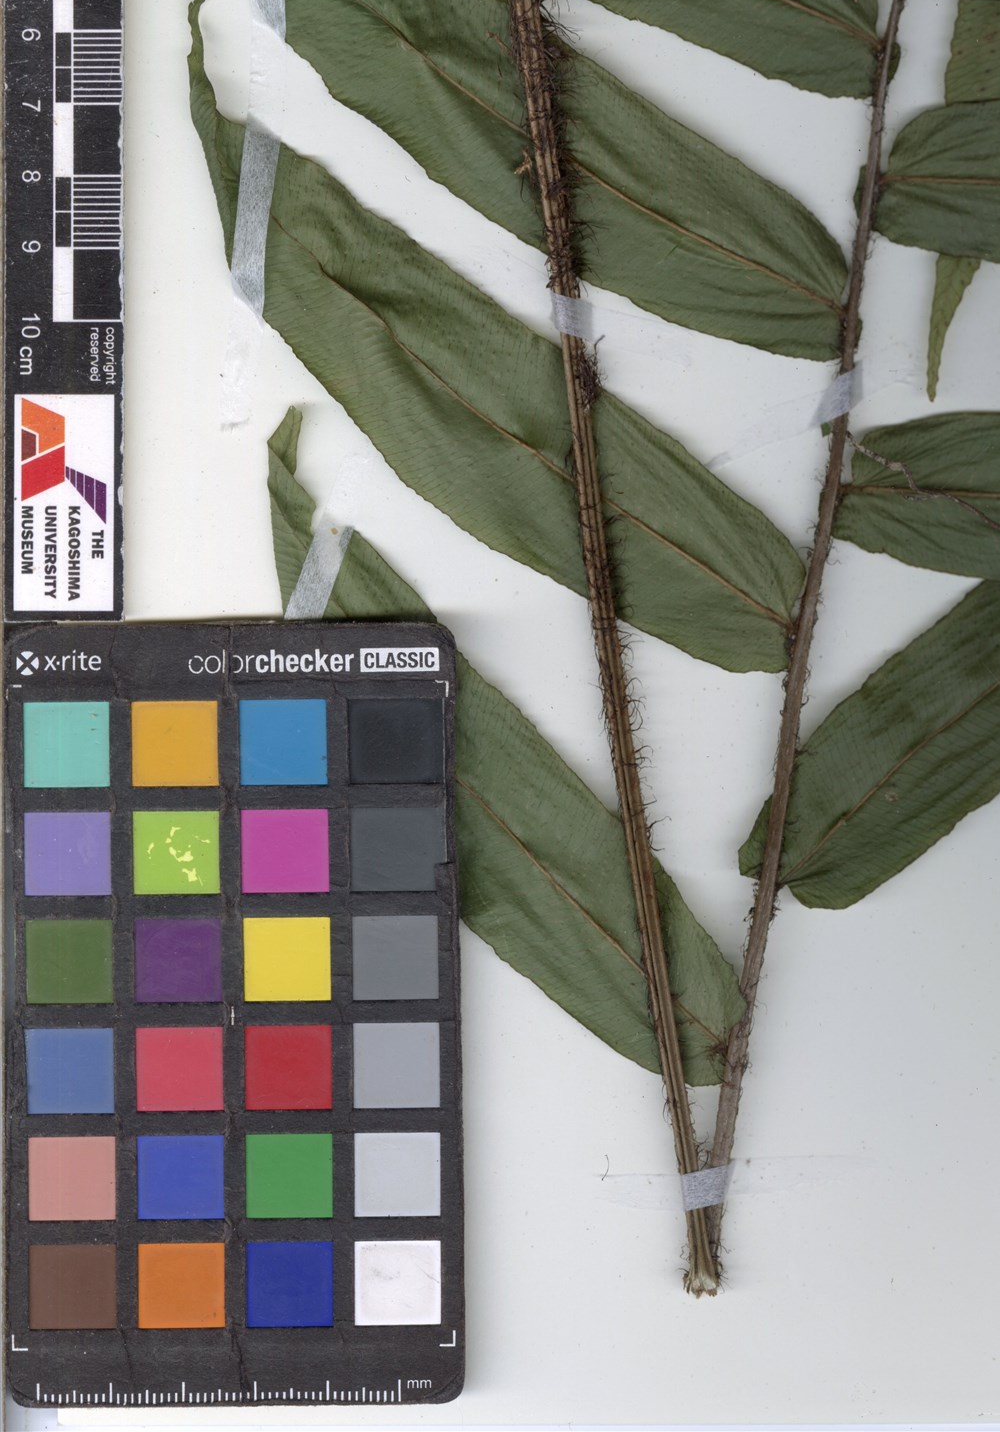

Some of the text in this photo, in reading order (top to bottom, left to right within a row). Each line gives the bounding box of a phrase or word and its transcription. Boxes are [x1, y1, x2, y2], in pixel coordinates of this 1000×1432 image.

[22, 29, 41, 41] 6
[22, 100, 41, 112] 7
[22, 170, 41, 182] 8
[22, 241, 41, 252] 9
[22, 314, 40, 338] 10
[20, 347, 32, 375] cm
[90, 328, 101, 381] reserved
[103, 327, 116, 384] copyright
[21, 506, 33, 574] MUSEUM
[45, 506, 57, 599] UNIVERSITY
[92, 530, 104, 559] THE
[68, 506, 80, 601] KAGOSHIMA
[364, 652, 435, 669] CLASSIC
[407, 1380, 431, 1388] mm
